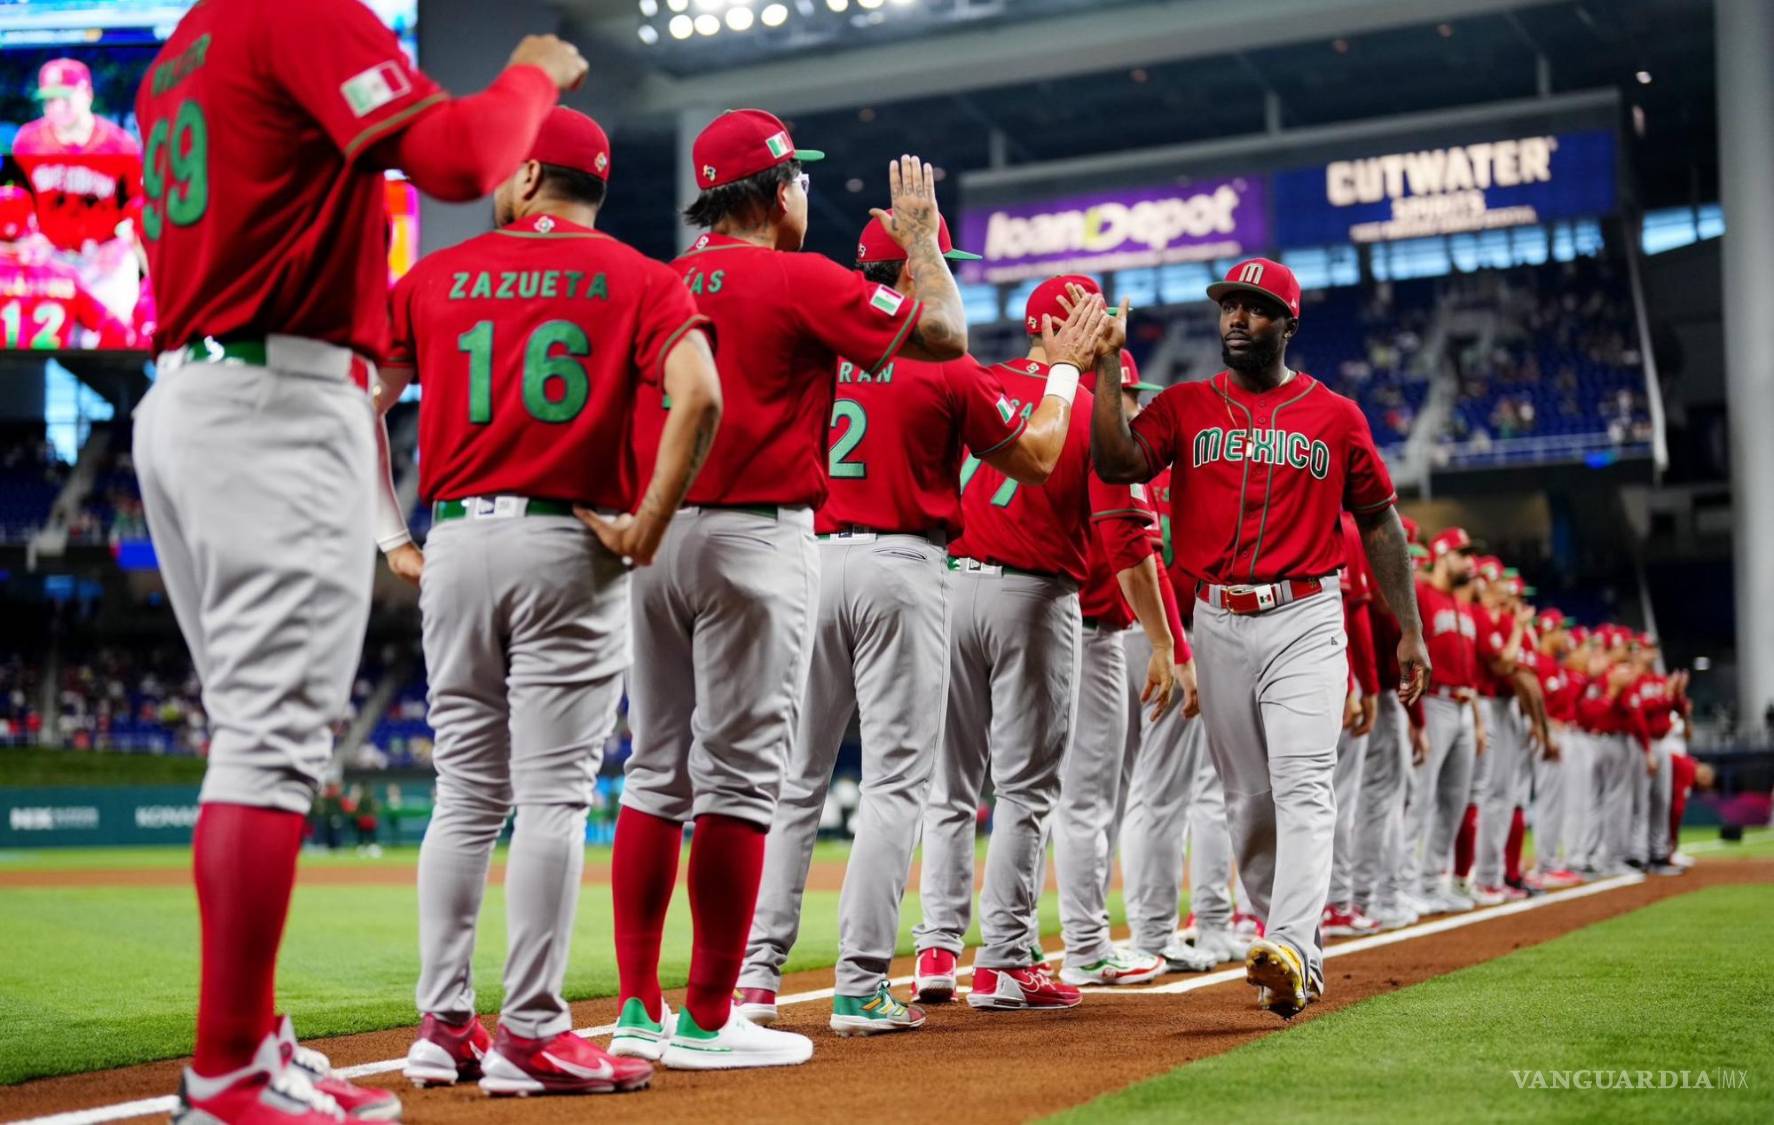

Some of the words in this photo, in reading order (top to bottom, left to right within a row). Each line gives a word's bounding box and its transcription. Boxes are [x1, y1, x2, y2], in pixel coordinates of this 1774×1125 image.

[1327, 137, 1551, 206] CUTWATER
[984, 185, 1239, 261] loanDepot
[449, 270, 608, 299] ZAZUETA
[0, 301, 65, 349] 12
[458, 319, 590, 424] 16
[1193, 427, 1330, 480] MEXICO
